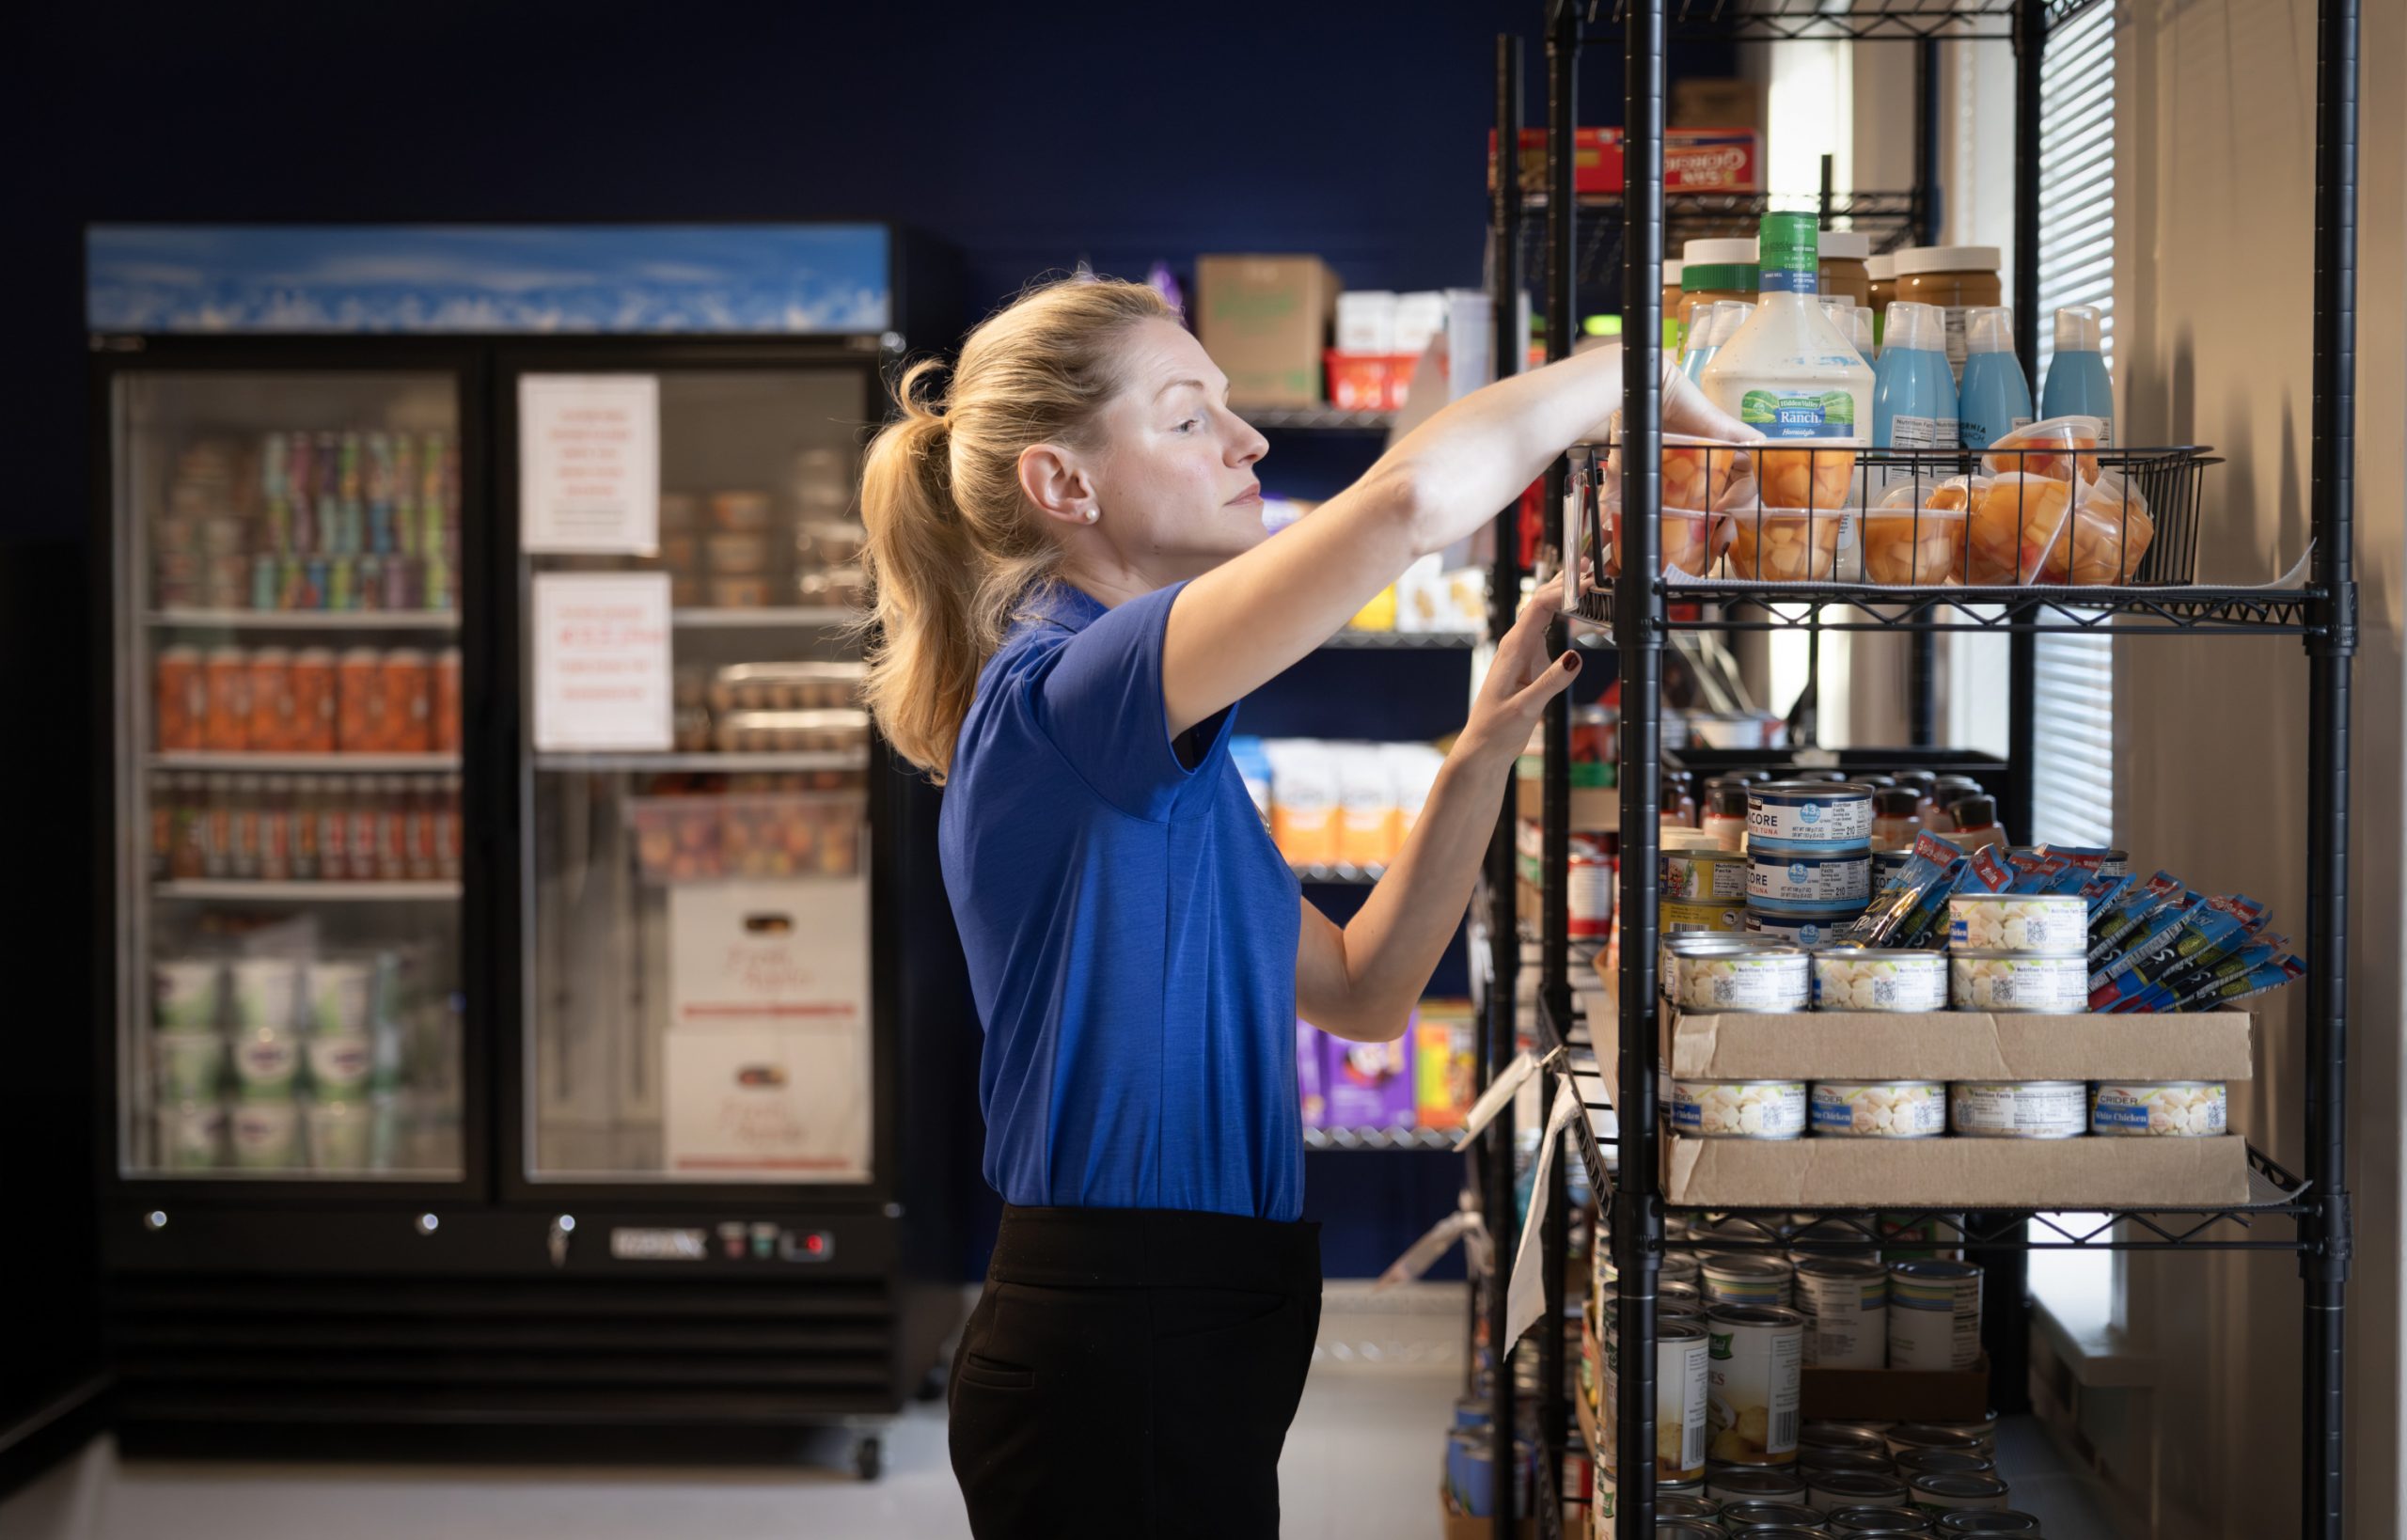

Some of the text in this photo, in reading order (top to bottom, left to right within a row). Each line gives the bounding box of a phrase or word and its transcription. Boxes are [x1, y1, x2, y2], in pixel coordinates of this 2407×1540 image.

[1802, 400, 1820, 408] Valley
[1783, 428, 1816, 436] Homestyle
[1760, 827, 1778, 836] TUNA
[1835, 887, 1846, 896] 210
[2100, 1094, 2138, 1105] CRIDER
[1823, 1111, 1850, 1122] Chicken
[2096, 1111, 2147, 1123] White Chicken
